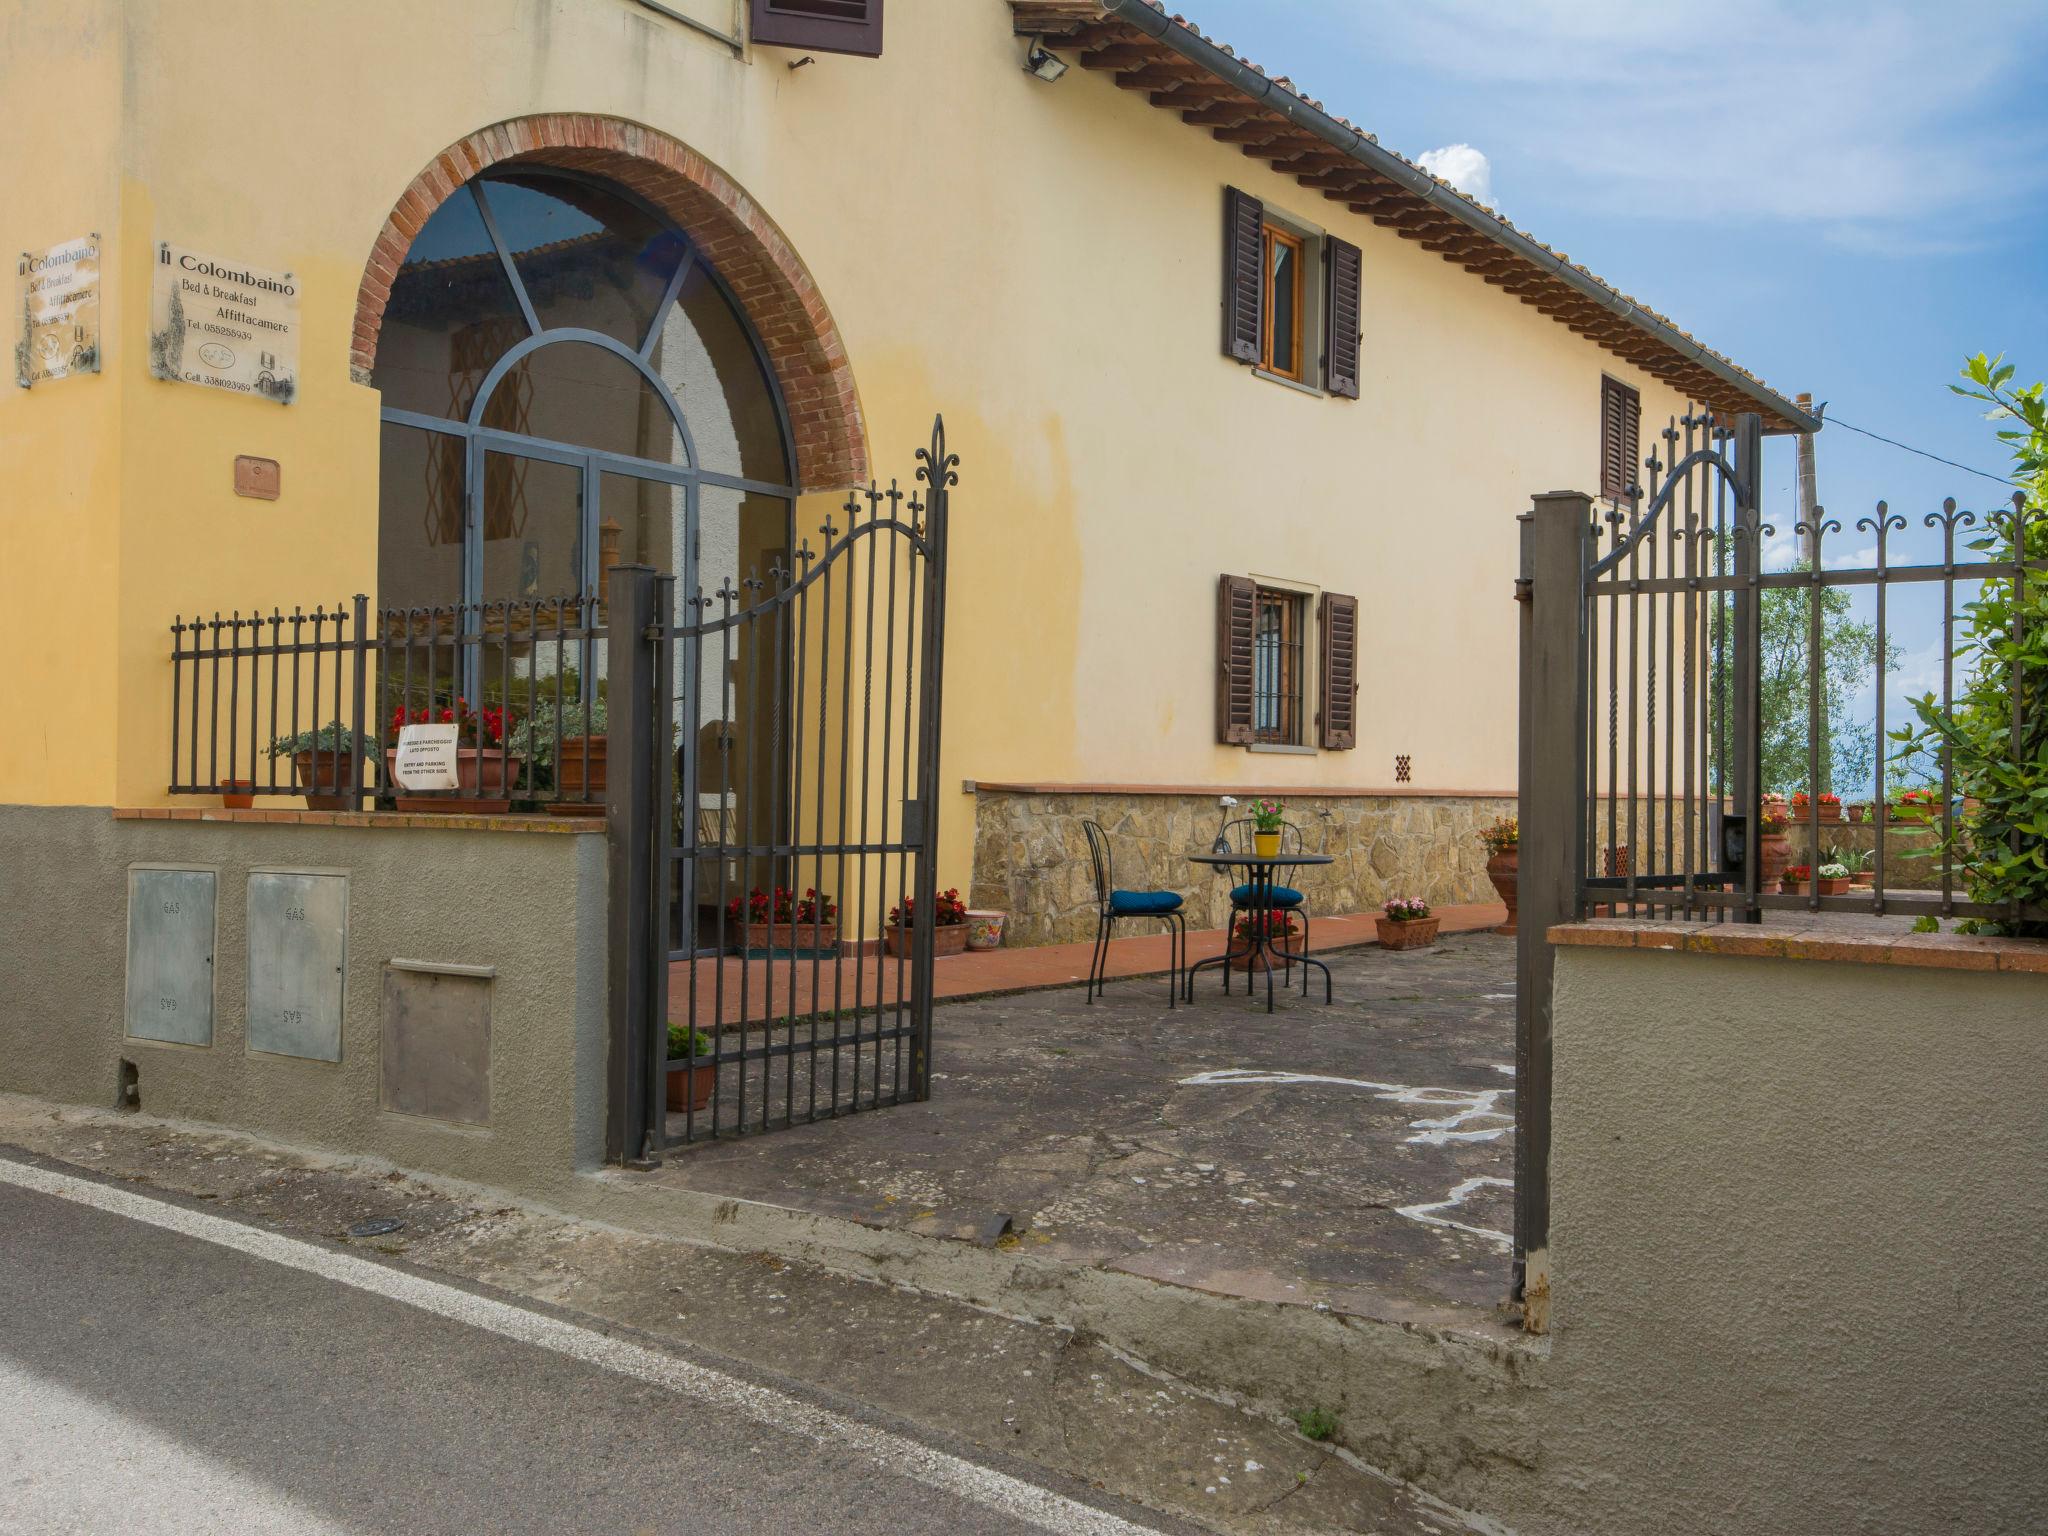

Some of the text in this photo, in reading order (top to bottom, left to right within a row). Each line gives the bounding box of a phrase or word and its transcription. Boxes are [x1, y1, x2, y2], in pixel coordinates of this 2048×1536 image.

[29, 245, 95, 273] Colombaino
[180, 255, 295, 296] Colombaino
[182, 278, 257, 307] Bed & Breakfast
[216, 307, 289, 333] Affittacamere
[163, 902, 180, 914] GAS
[285, 907, 305, 921] GAS
